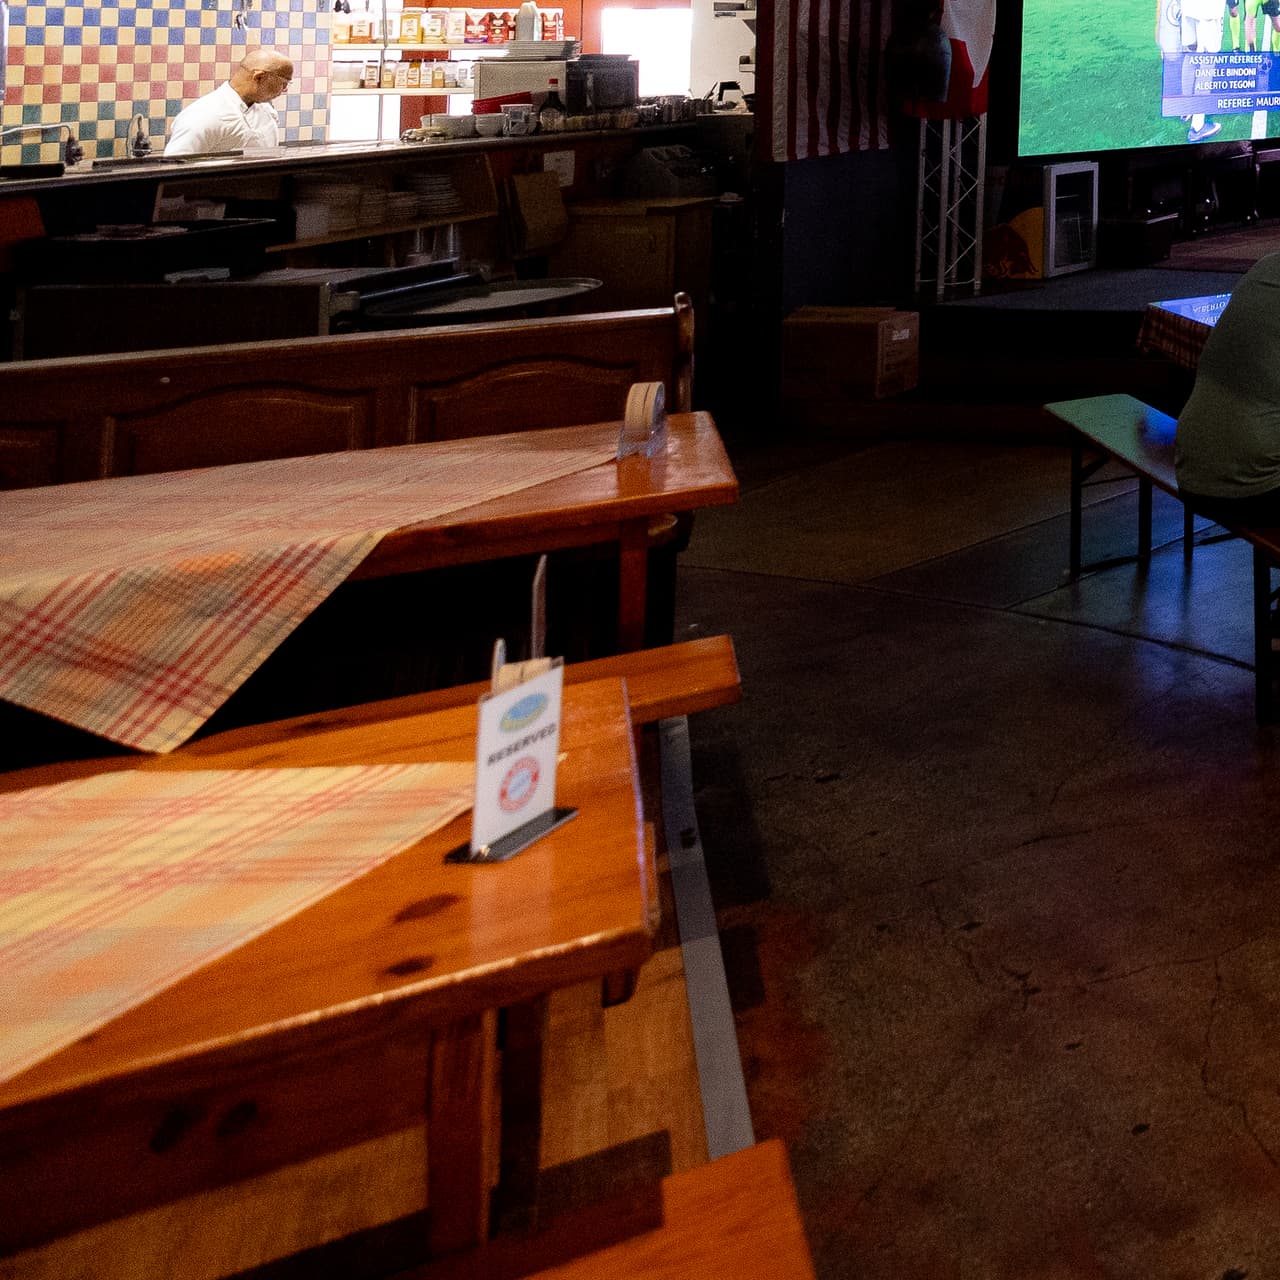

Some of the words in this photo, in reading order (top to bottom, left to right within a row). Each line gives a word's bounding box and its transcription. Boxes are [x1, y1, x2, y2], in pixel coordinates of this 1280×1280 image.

[1189, 55, 1229, 65] ASSISTANT
[1229, 54, 1263, 64] REFEREES
[1226, 67, 1257, 77] BINDONI
[1195, 81, 1228, 90] ALBERTO
[1229, 80, 1256, 89] TEGONI
[487, 722, 557, 767] RESERVED
